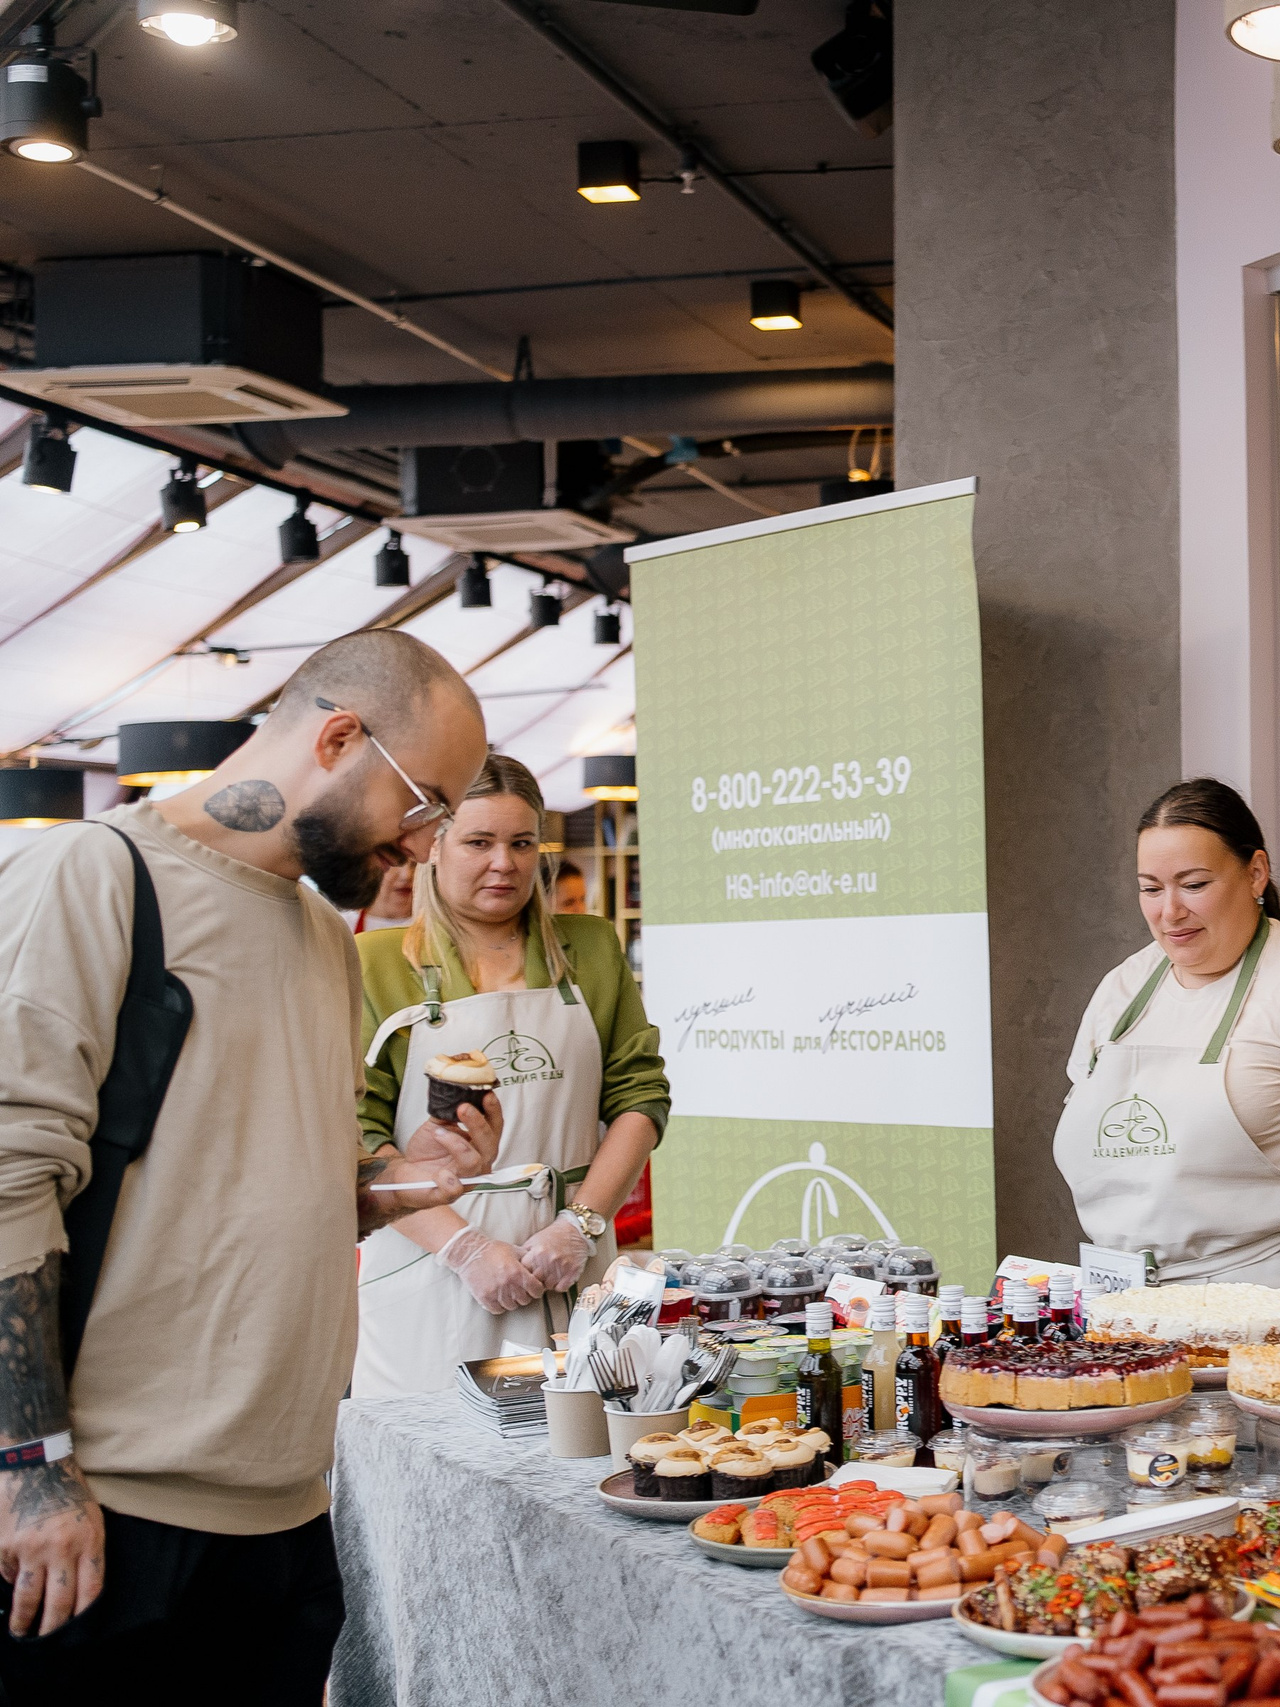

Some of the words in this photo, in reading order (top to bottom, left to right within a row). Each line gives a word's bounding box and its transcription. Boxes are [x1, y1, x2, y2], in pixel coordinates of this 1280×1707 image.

[691, 756, 912, 813] 8-800-222-53-39
[712, 813, 891, 854] (многоканальный)
[726, 869, 877, 900] HQ-info@ak-e.ru
[696, 1029, 784, 1052] ПРОДУКТЫ
[793, 1035, 822, 1053] для
[830, 1030, 946, 1053] РЕСТОРАНОВ
[502, 1073, 537, 1087] ЕМИЯ
[896, 1376, 909, 1431] ROPPY
